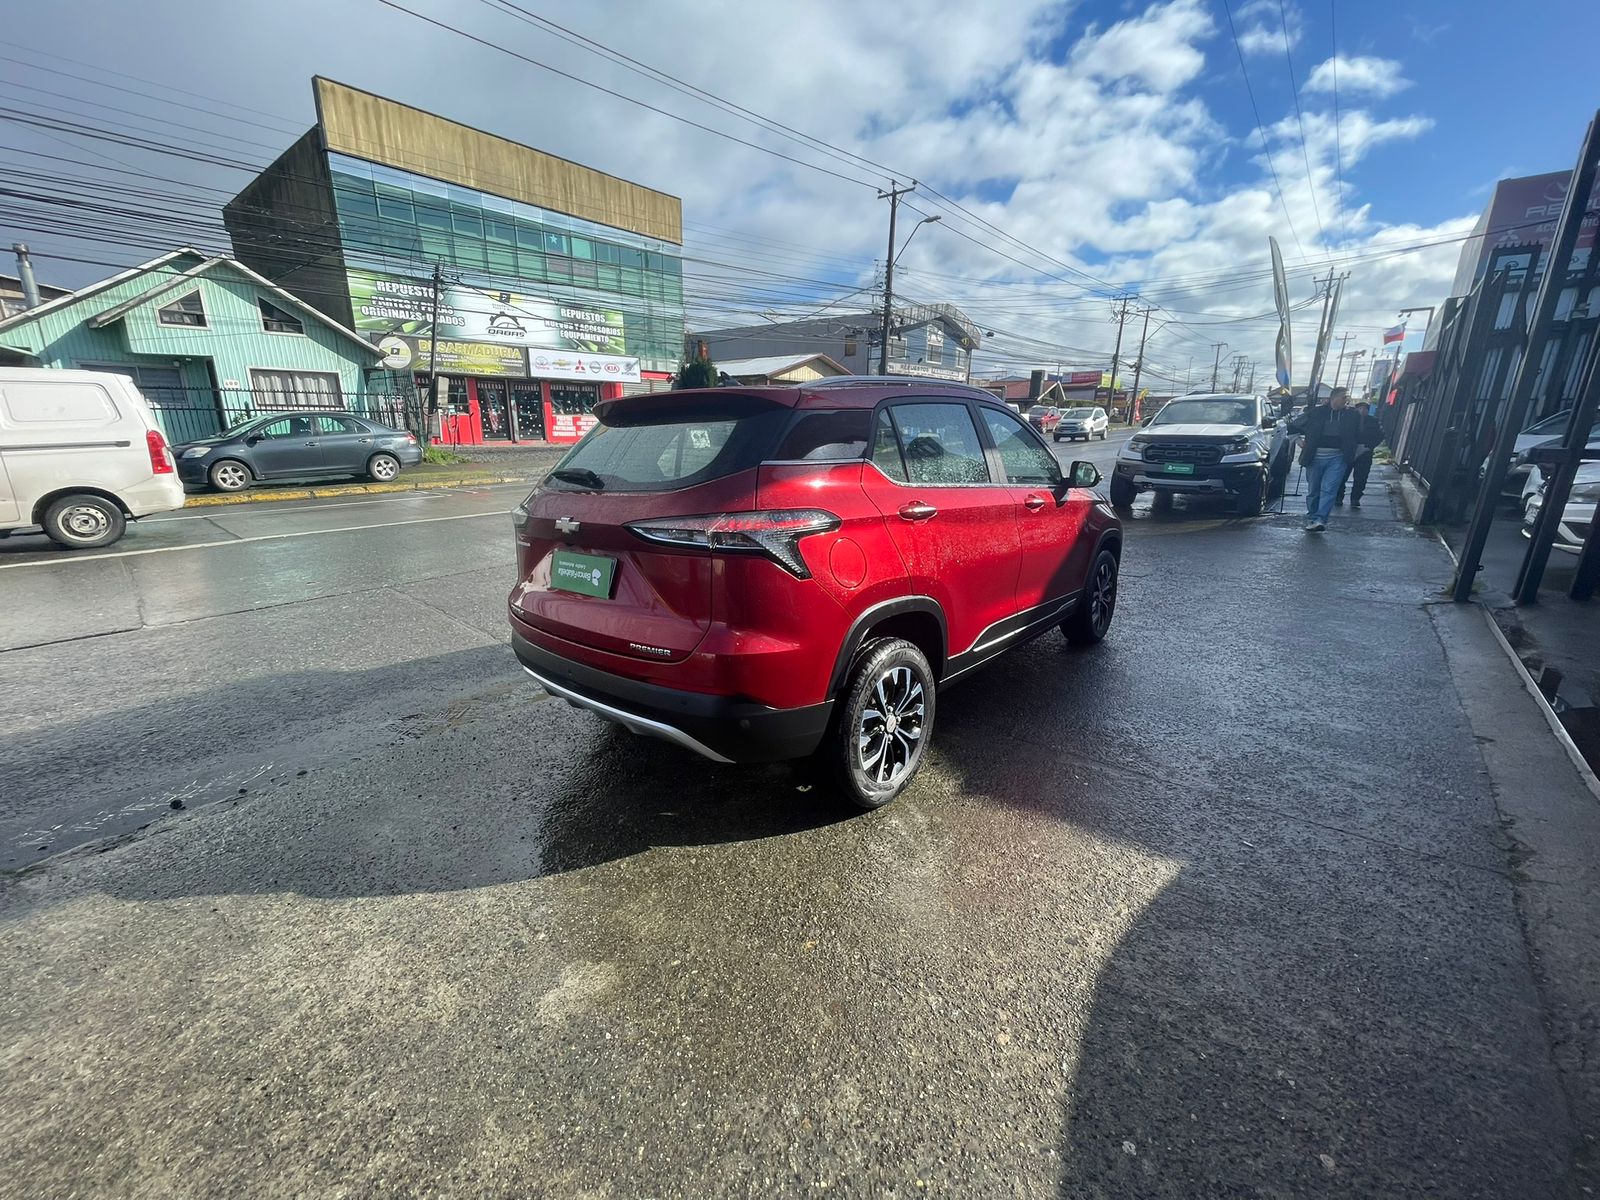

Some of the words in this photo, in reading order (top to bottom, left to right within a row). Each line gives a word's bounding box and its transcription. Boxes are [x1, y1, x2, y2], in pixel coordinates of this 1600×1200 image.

[560, 308, 606, 323] REPUESTOS
[560, 329, 610, 344] EQUIPAMIENTO
[629, 642, 671, 657] PREMIER
